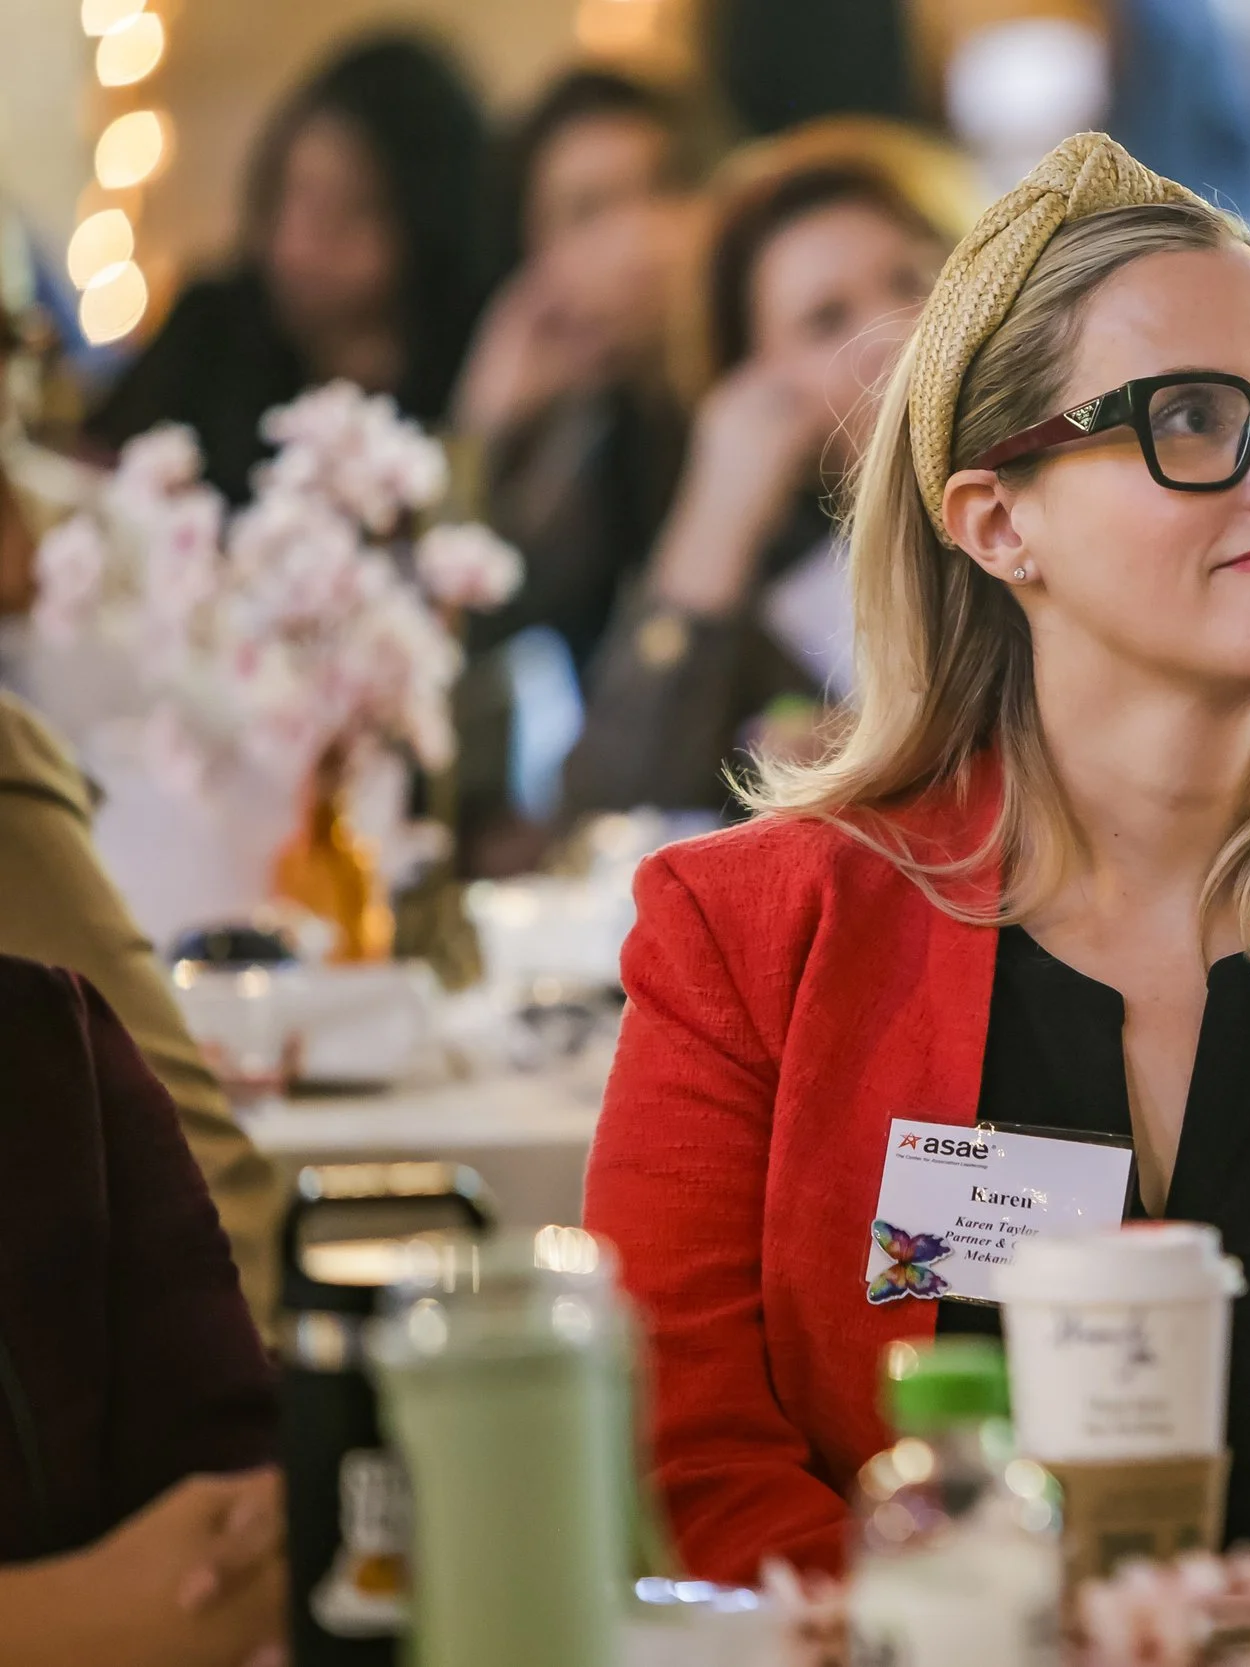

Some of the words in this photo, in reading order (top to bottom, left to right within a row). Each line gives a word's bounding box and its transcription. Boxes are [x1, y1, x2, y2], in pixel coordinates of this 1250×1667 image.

[923, 1137, 989, 1160] asae
[971, 1185, 1032, 1209] Karen
[955, 1216, 993, 1231] Karen
[999, 1221, 1039, 1236] Taylor
[945, 1230, 992, 1246] Partner
[995, 1238, 1006, 1249] &
